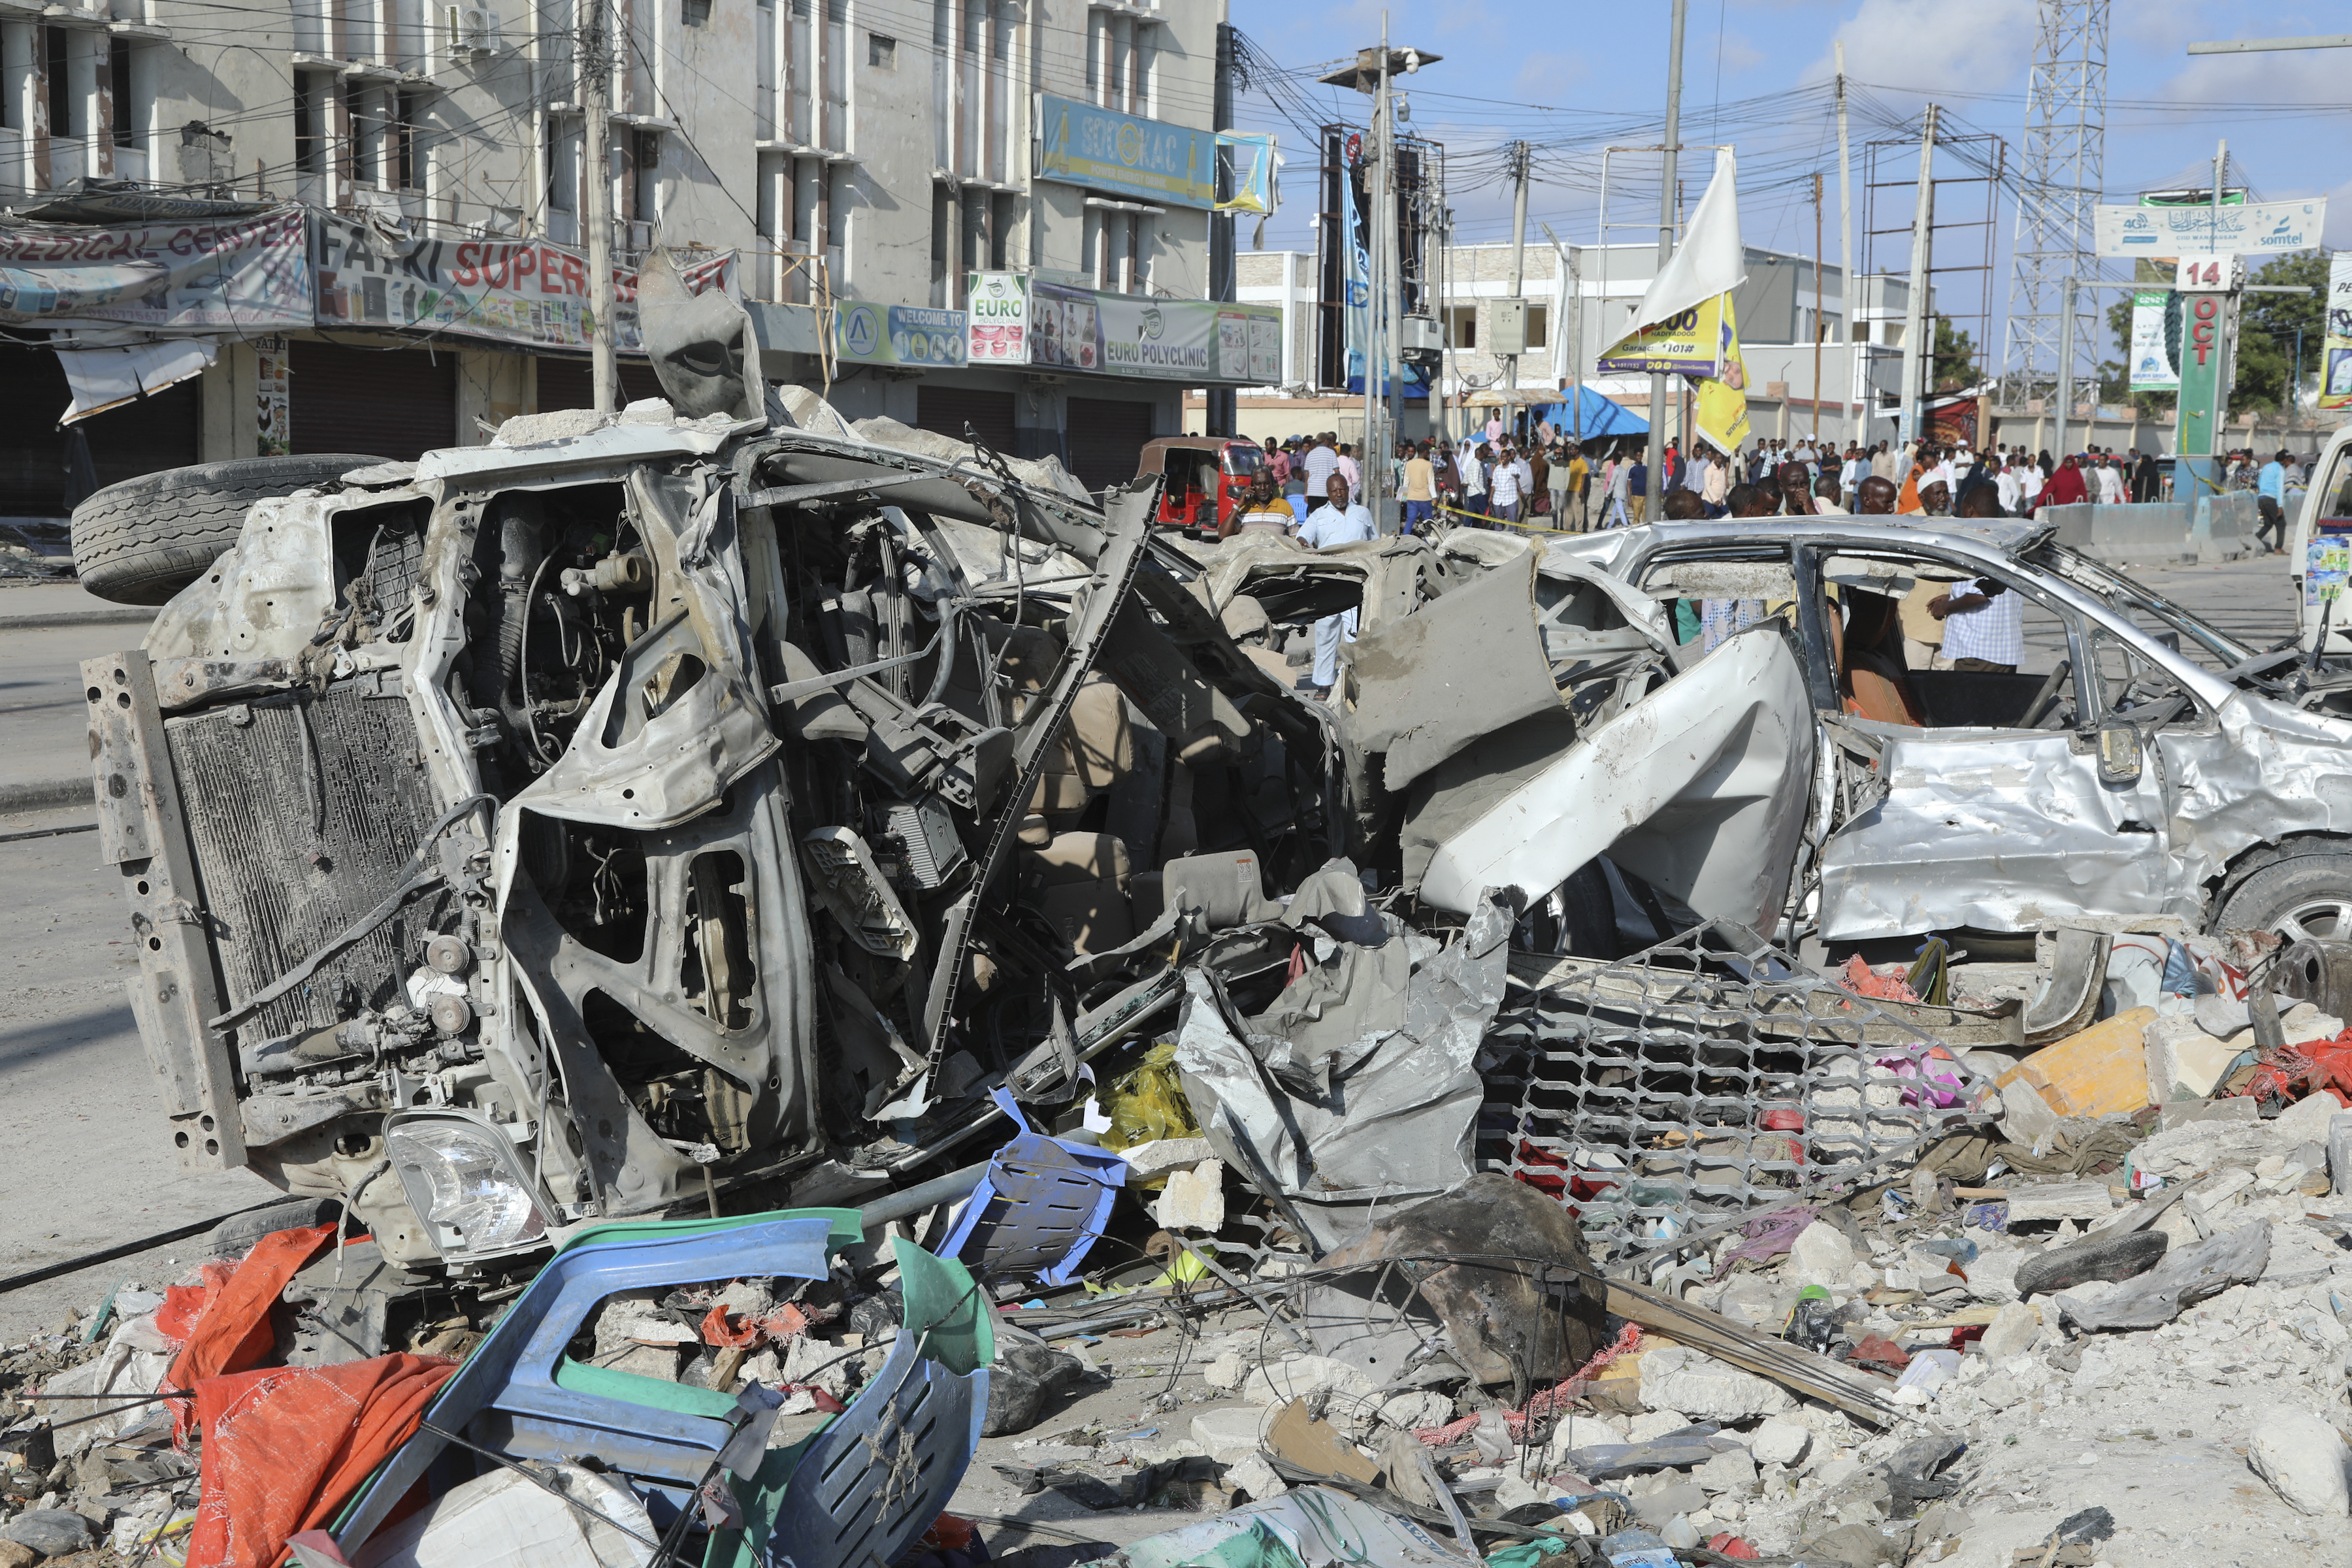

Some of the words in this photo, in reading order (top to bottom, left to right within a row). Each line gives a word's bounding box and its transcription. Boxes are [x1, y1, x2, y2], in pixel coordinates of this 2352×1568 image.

[1090, 164, 1116, 178] POWER
[1118, 169, 1144, 184] ENERGY
[1145, 175, 1166, 188] DRINK
[105, 197, 162, 211] SAHAN
[0, 230, 159, 261] MEDICAL
[168, 212, 304, 256] CENTER
[2261, 233, 2302, 246] somtel
[319, 215, 443, 284] FAKI
[2187, 262, 2220, 285] 14
[898, 309, 947, 325] WELCOME
[949, 314, 962, 326] TO
[975, 299, 1022, 318] EURO
[2191, 297, 2217, 365] OCT
[256, 338, 286, 350] FATI
[1107, 340, 1139, 362] EURO
[1142, 344, 1207, 367] POLYCLINIC
[1622, 344, 1654, 352] Garaac:
